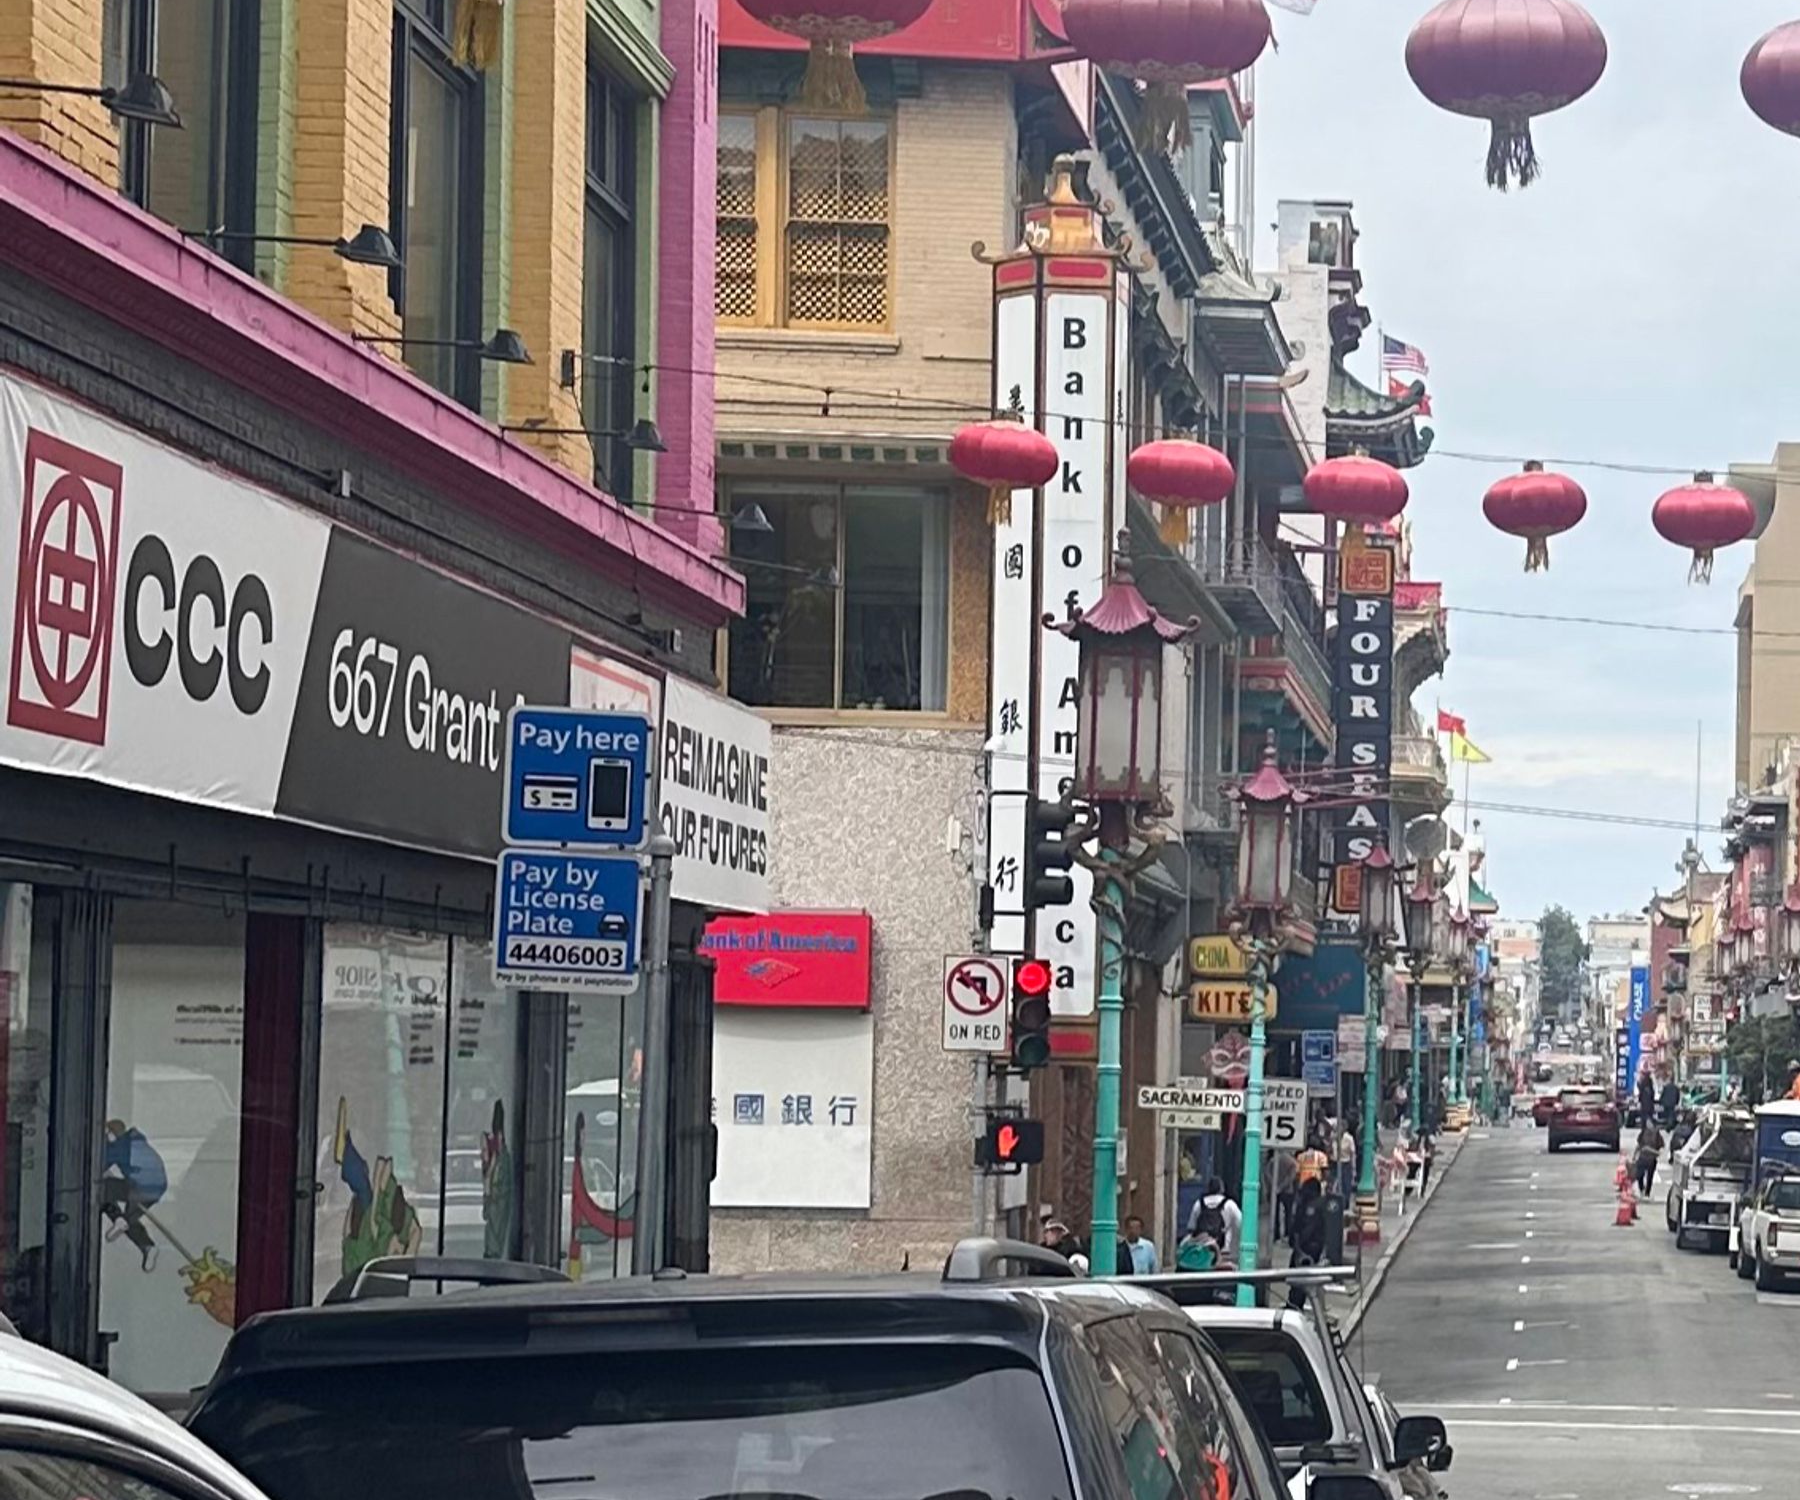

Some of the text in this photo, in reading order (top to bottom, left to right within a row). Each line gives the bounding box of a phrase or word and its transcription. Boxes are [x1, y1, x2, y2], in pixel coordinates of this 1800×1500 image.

[1062, 318, 1087, 494] Bank
[123, 534, 273, 715] CCC
[1350, 600, 1381, 718] FOUR
[328, 628, 500, 771] 667 Grant
[518, 723, 640, 755] Pay here
[663, 720, 768, 812] REIMAGINE
[1347, 743, 1377, 860] SEAS
[659, 800, 767, 876] OUR FUTURES
[1054, 677, 1080, 990] Ameca
[510, 861, 599, 890] Pay by
[509, 886, 605, 912] License
[507, 910, 574, 935] Plate
[509, 941, 625, 968] 44406003
[701, 929, 857, 953] ank of America
[496, 972, 512, 983] Pay
[515, 973, 527, 983] by
[529, 973, 558, 984] phone
[949, 1024, 1001, 1042] ON RED
[1140, 1089, 1242, 1108] SACRAMENTO
[1262, 1100, 1298, 1112] LIMIT
[1264, 1114, 1296, 1141] 15
